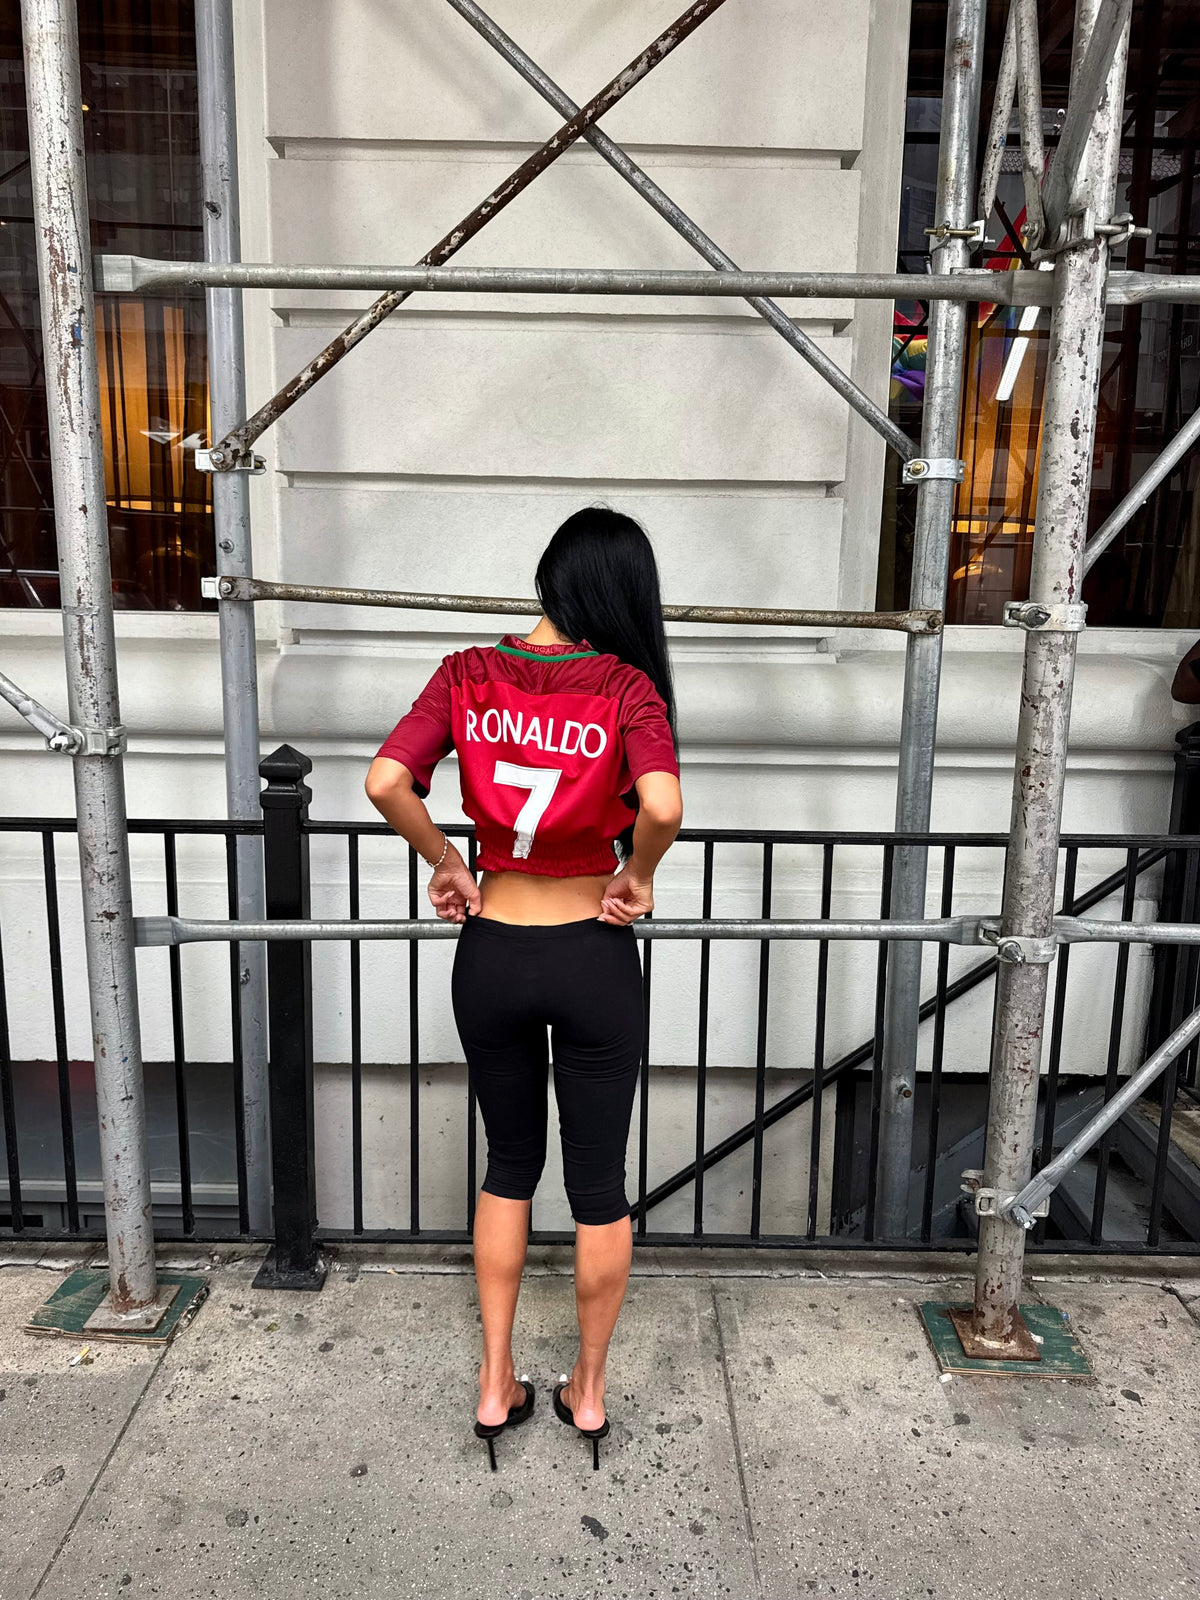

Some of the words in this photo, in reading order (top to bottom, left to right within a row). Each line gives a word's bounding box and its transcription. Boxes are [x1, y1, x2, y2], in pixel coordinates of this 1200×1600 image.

[515, 639, 554, 654] PORTUGAL
[466, 708, 607, 759] RONALDO
[493, 760, 563, 860] 7
